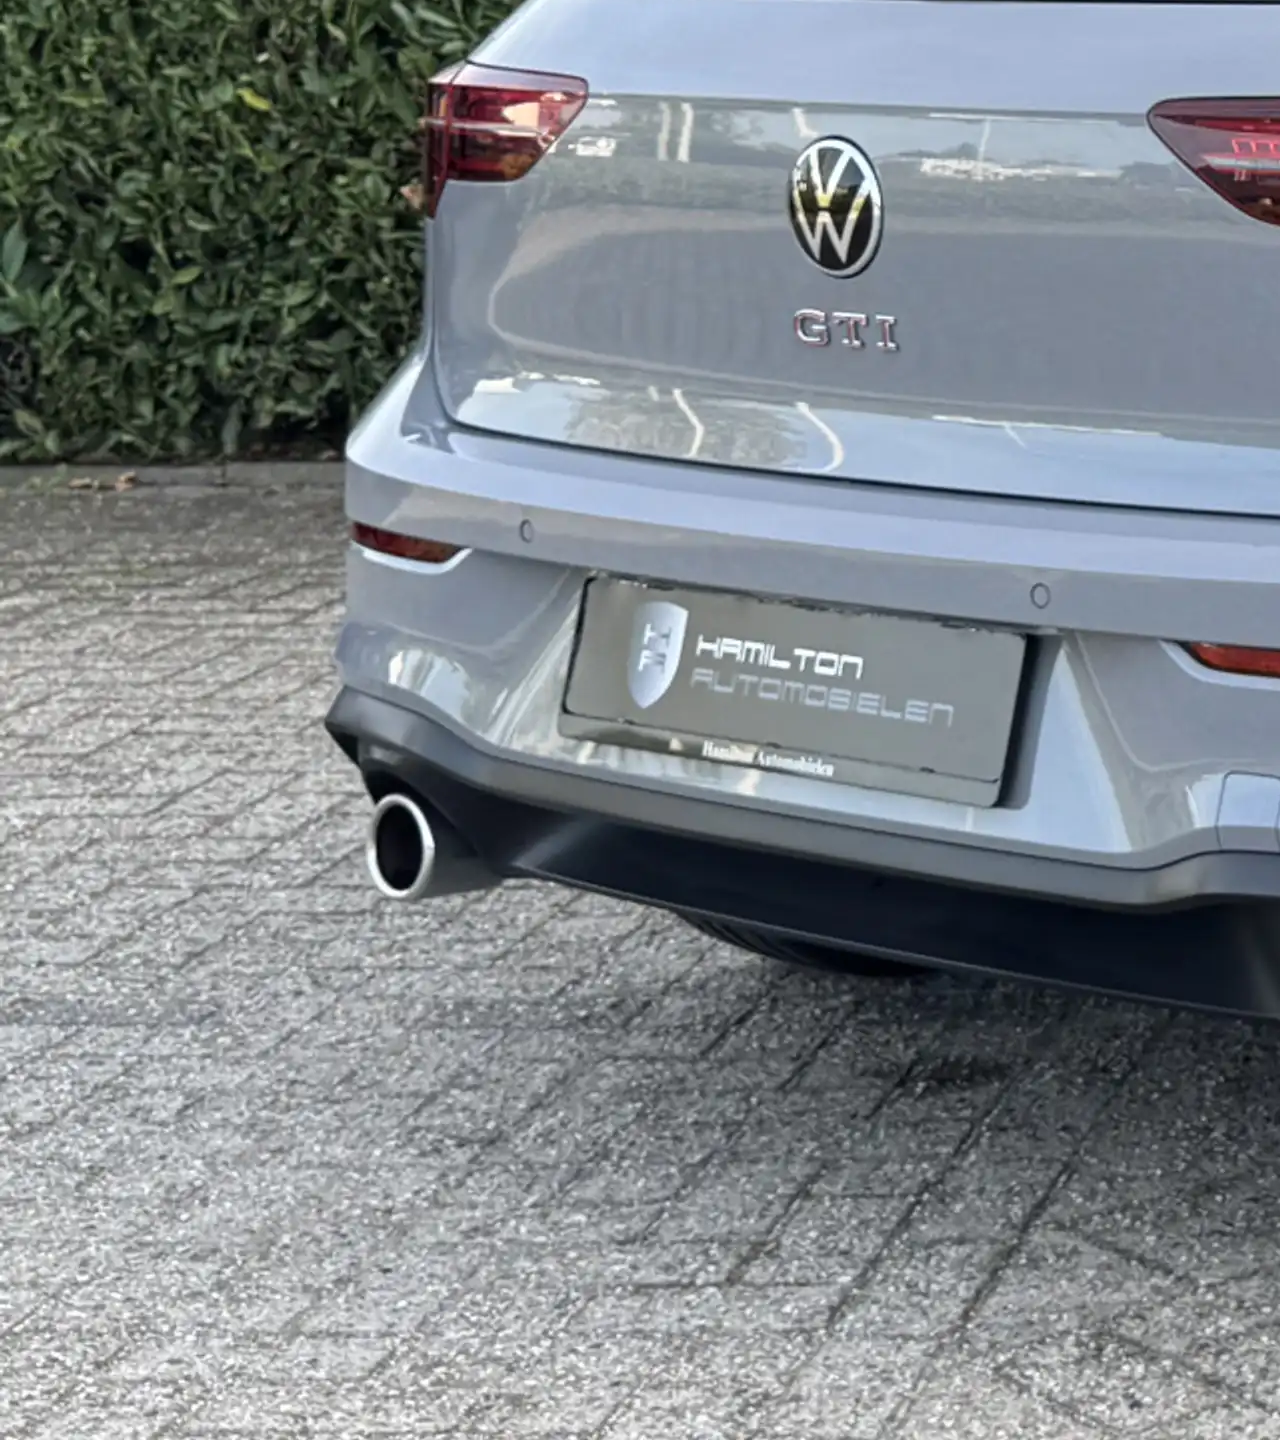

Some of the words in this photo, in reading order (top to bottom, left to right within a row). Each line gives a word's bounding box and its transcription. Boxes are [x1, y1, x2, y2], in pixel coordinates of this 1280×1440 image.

[794, 308, 900, 350] GTI
[695, 633, 864, 680] HAMILTON
[690, 668, 954, 727] AUTOMOBIELEN
